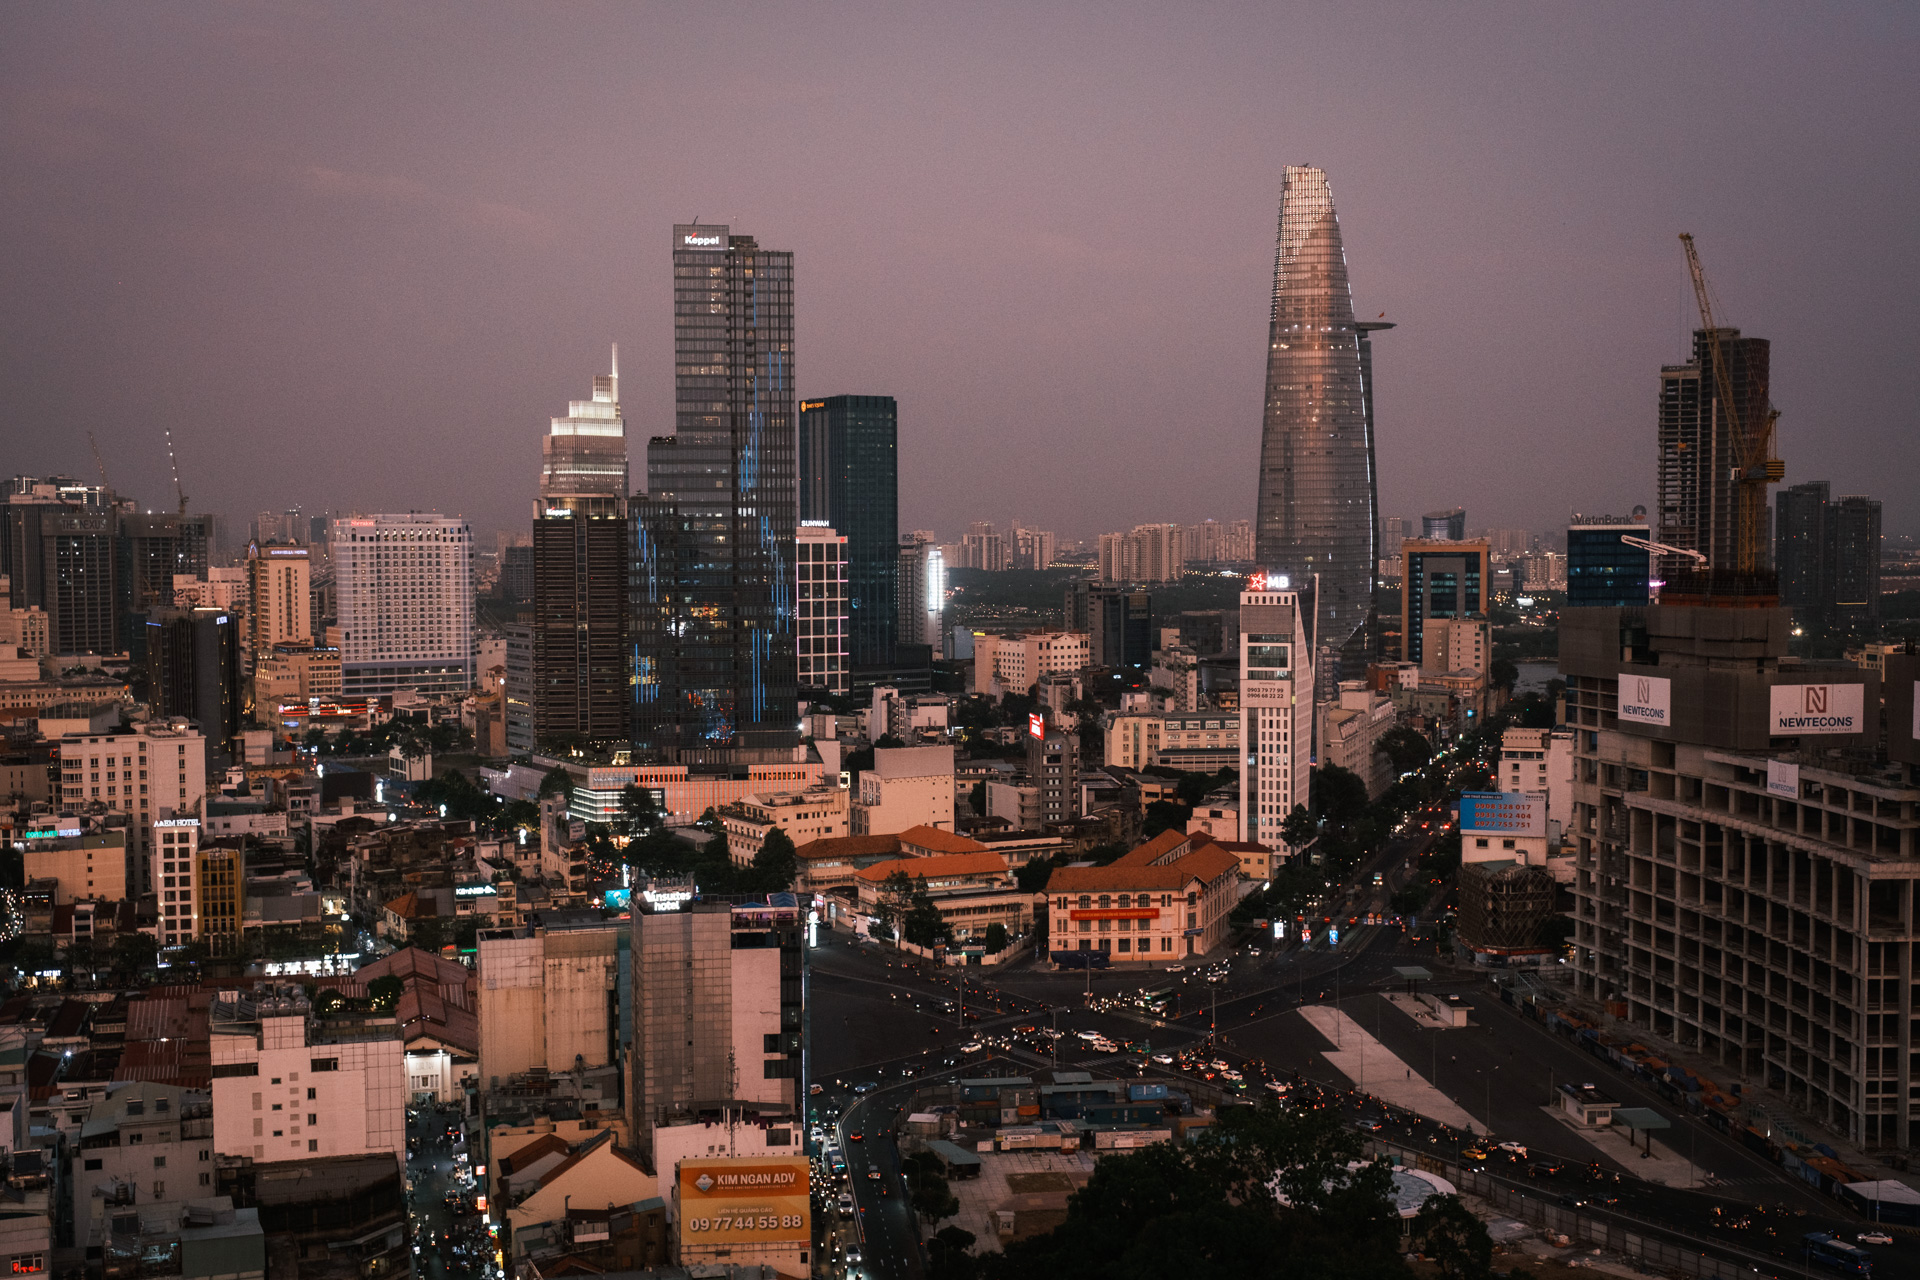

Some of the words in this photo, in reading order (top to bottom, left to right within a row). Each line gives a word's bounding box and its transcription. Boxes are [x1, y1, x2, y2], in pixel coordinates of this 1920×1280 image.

[684, 234, 719, 246] Keppel
[62, 520, 75, 529] THE
[79, 520, 106, 529] NEXUS
[1576, 514, 1632, 525] VietinBank
[1267, 576, 1289, 588] MB
[1623, 704, 1664, 719] NEWTECONS
[1779, 716, 1853, 728] NEWTECONS
[1769, 782, 1795, 794] NEWTECONS
[177, 818, 201, 826] HOTEL
[59, 828, 81, 836] HOTEL
[654, 900, 680, 911] hotel
[717, 1174, 738, 1185] KIM
[740, 1173, 771, 1185] NGAN
[773, 1172, 795, 1183] ADV
[690, 1218, 710, 1231] 09
[713, 1217, 733, 1230] 77
[734, 1216, 755, 1229] 44
[758, 1215, 778, 1229] 55
[781, 1214, 802, 1228] 88
